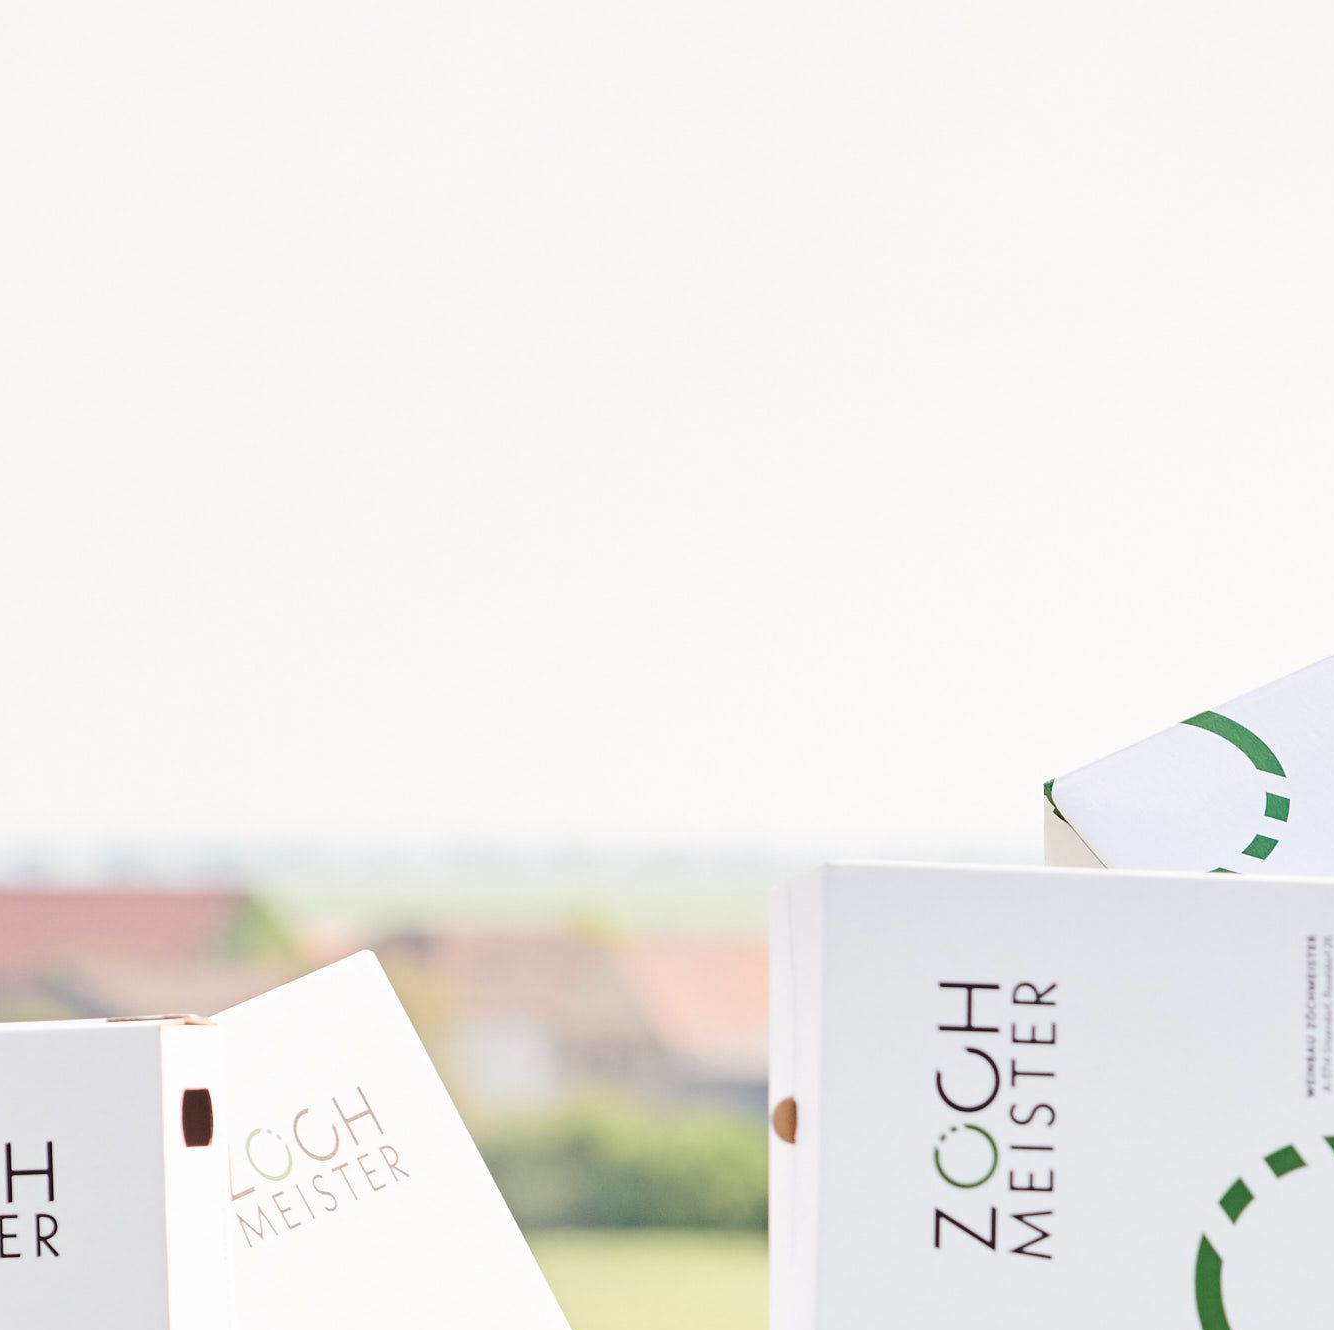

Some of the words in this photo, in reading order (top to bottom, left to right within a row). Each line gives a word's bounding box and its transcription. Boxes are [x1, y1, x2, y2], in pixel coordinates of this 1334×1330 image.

[1305, 935, 1316, 1029] ZÖCHMEISTER
[1307, 1036, 1316, 1097] WEINBAU
[1011, 979, 1057, 1260] MEISTER
[236, 1145, 410, 1248] MEISTER
